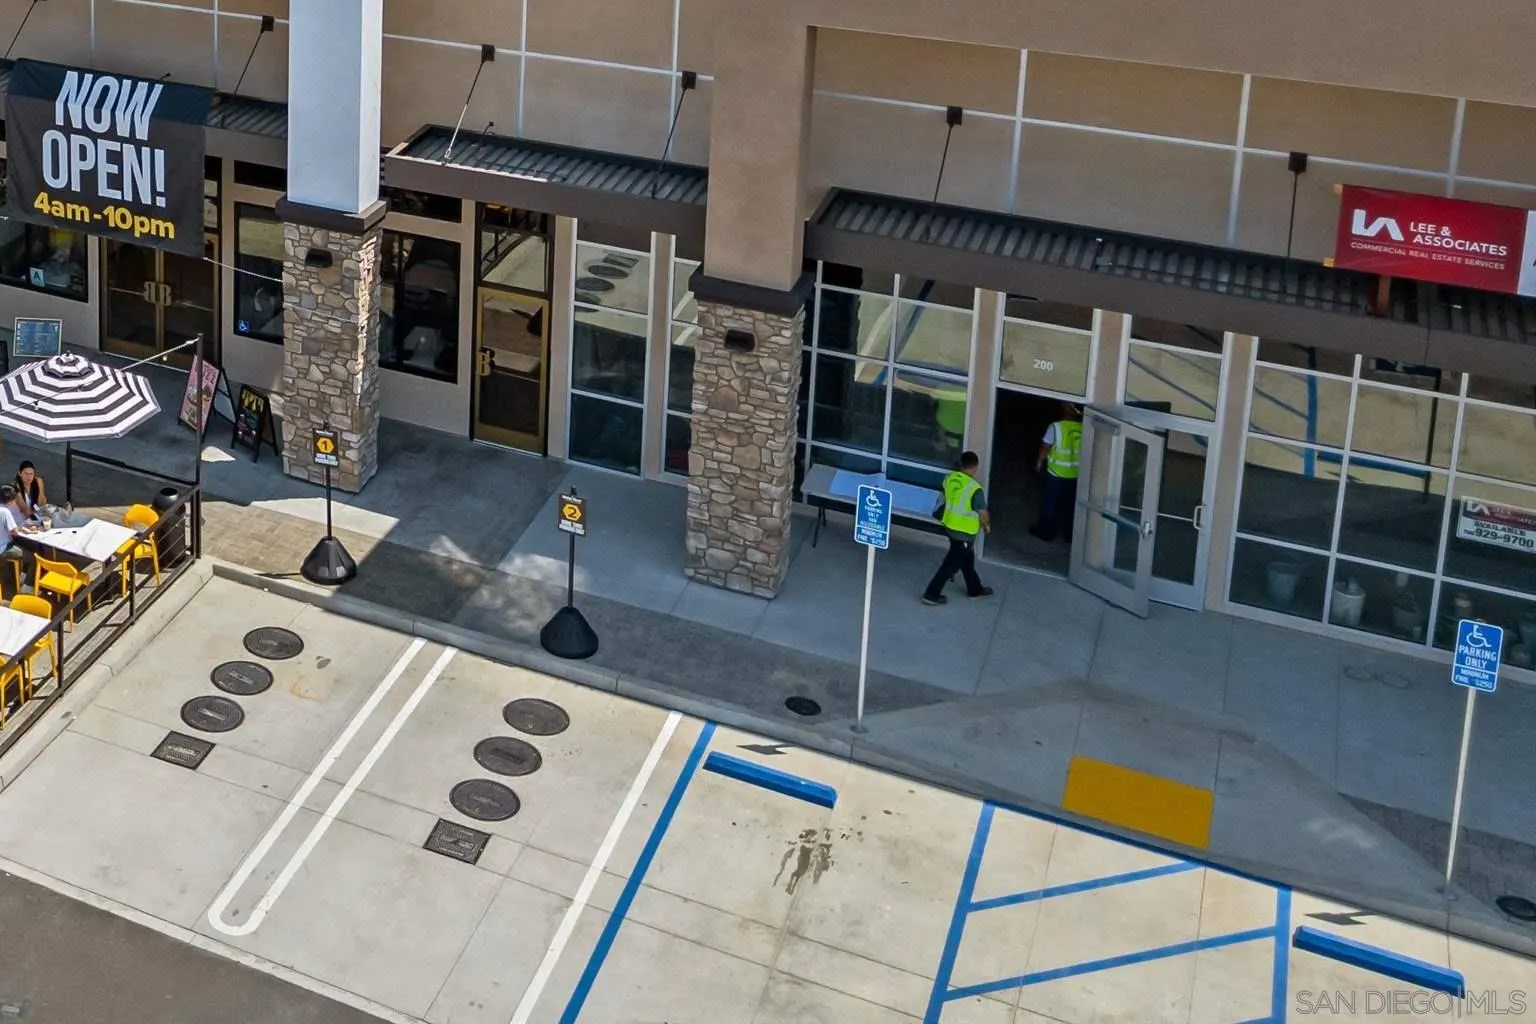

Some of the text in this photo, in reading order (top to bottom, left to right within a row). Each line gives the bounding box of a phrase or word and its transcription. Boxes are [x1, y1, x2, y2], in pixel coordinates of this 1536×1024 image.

[55, 70, 164, 141] NOW
[42, 129, 167, 208] OPEN!
[1409, 221, 1452, 237] LEE &
[1412, 234, 1508, 256] ASSOCIATES
[1351, 242, 1505, 270] COMMERCIAL REAL ESTATE SERVICES
[1033, 358, 1054, 372] 200
[321, 440, 328, 451] 1
[567, 506, 577, 519] 2
[1474, 521, 1526, 536] AVAILABLE
[1459, 644, 1497, 661] PARKING
[1465, 656, 1488, 669] ONLY
